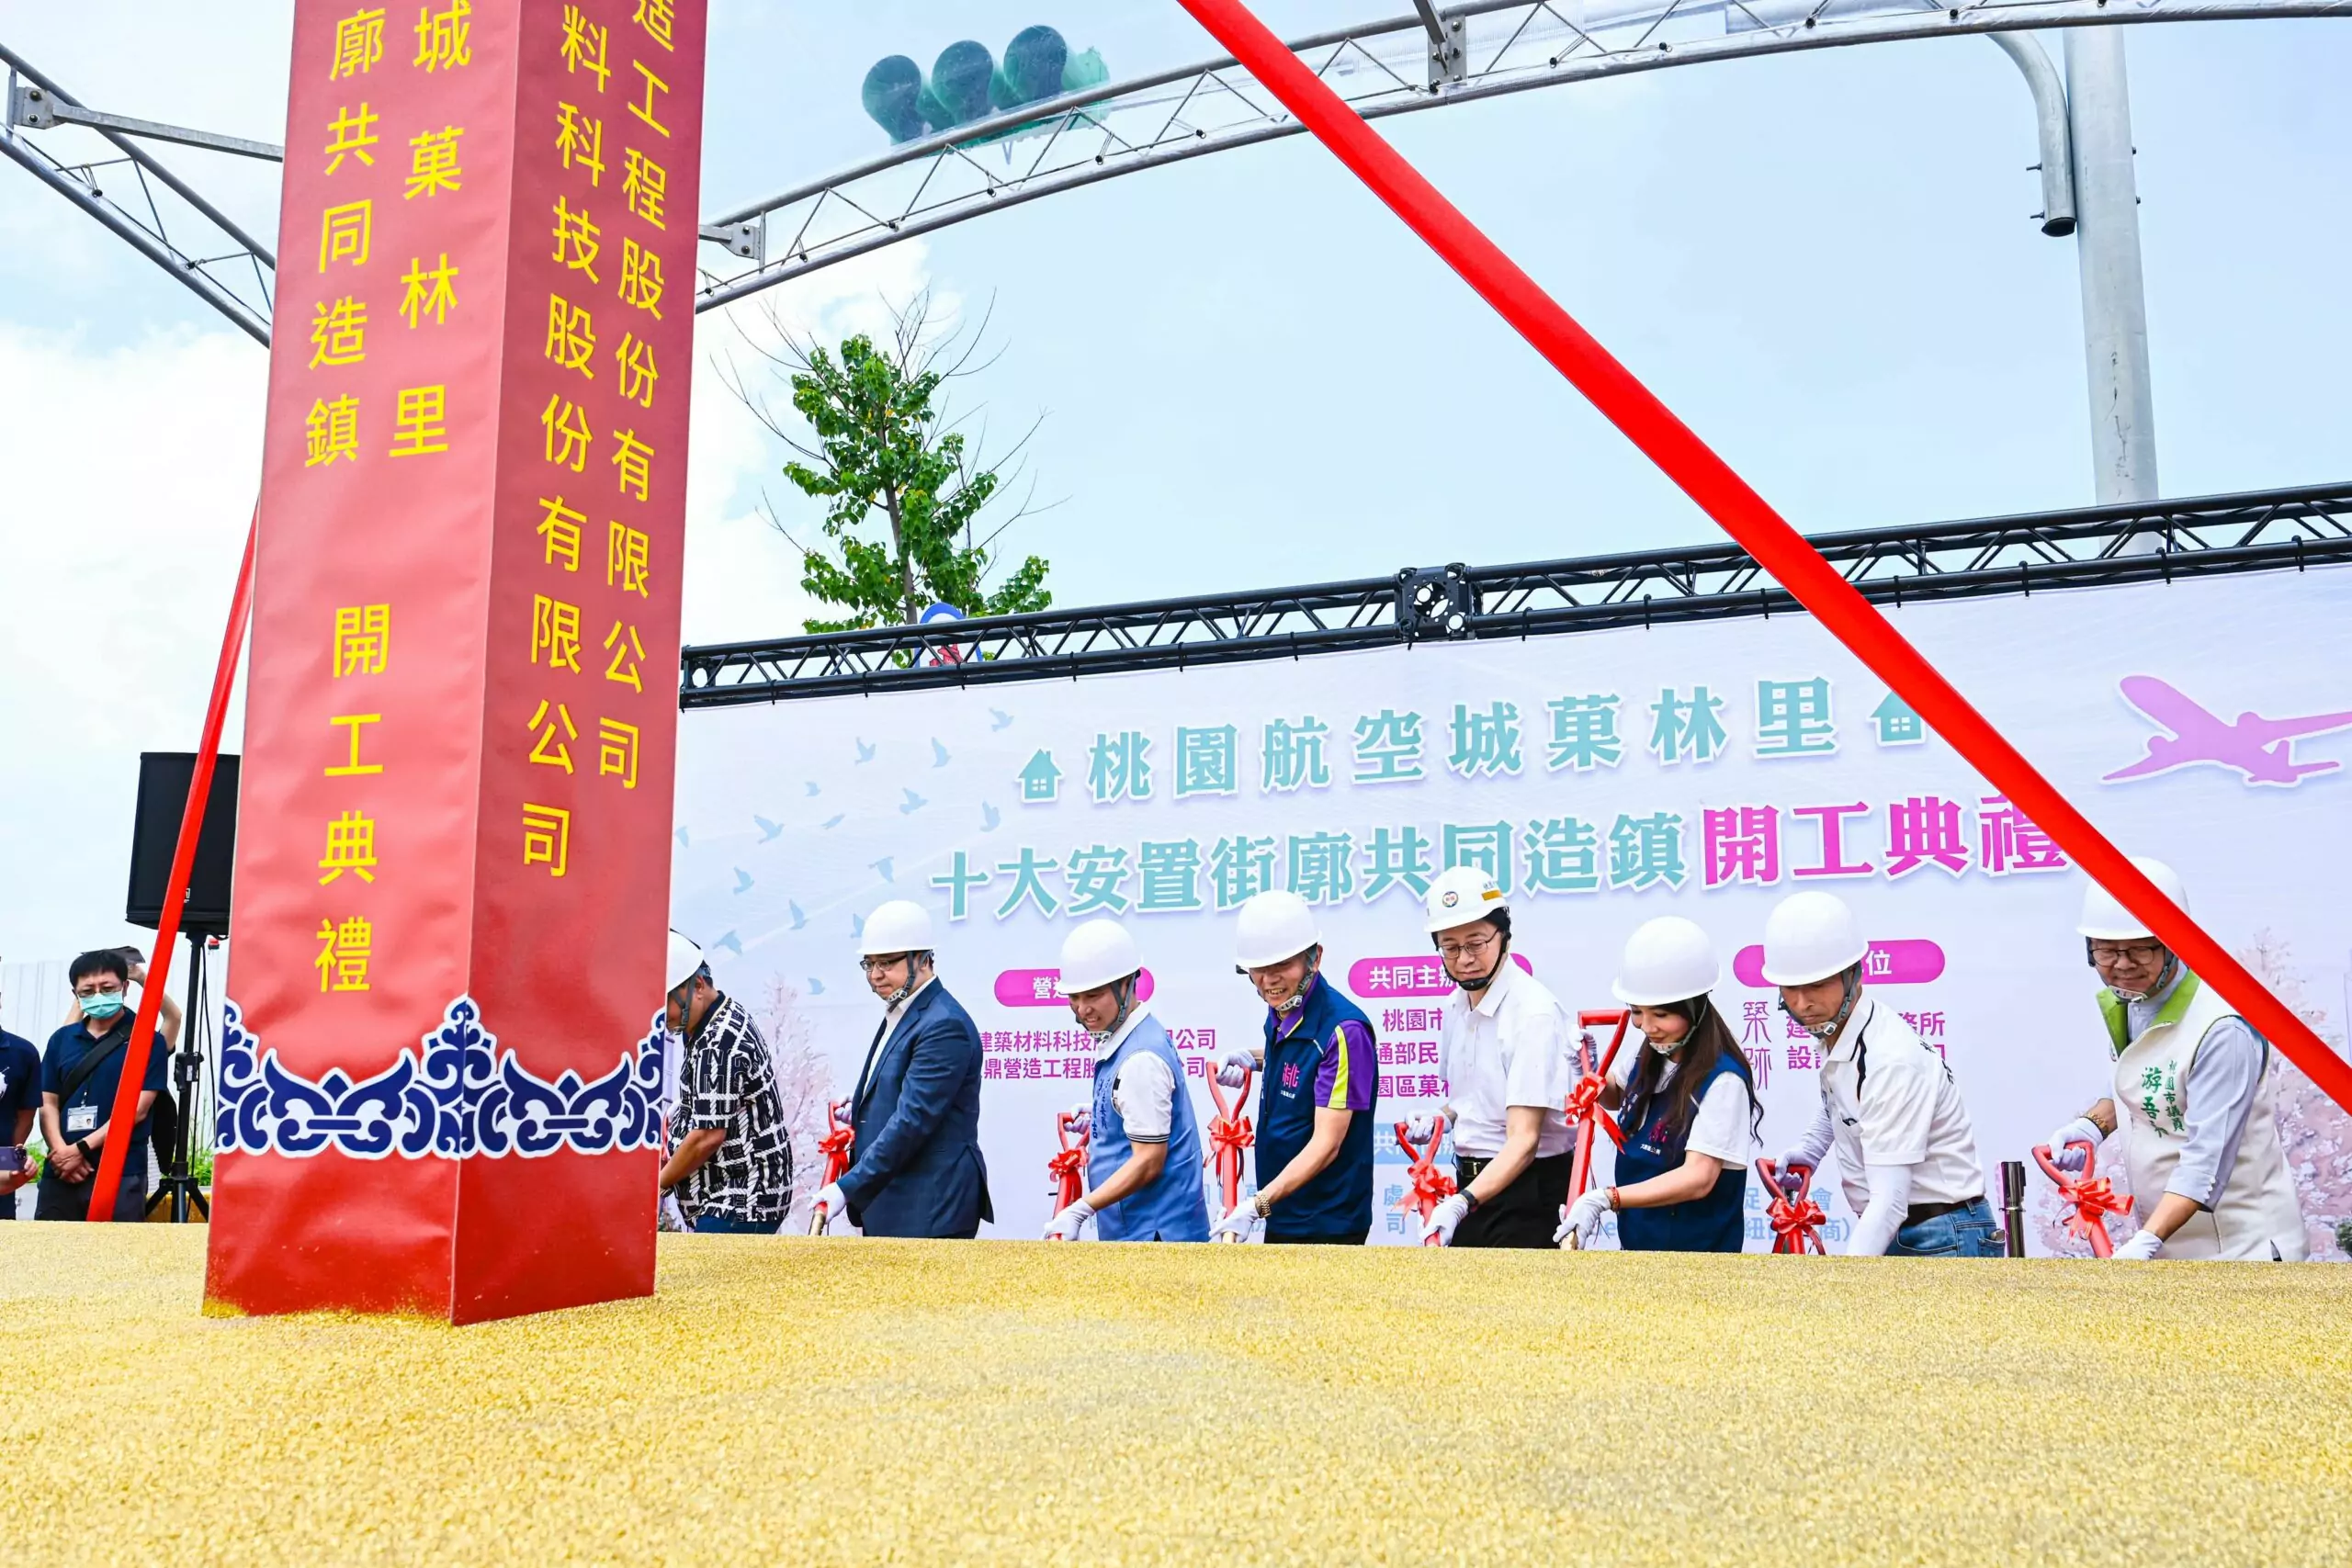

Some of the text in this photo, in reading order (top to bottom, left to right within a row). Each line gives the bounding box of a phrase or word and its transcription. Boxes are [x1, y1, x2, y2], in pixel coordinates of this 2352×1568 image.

[305, 7, 386, 468] 廓共同造鎮
[388, 0, 472, 457] 城菓林里
[522, 5, 611, 877] 料科技股份有限公司
[314, 603, 390, 993] 開工典禮
[1089, 676, 1835, 801] 桃園航空城菓林里
